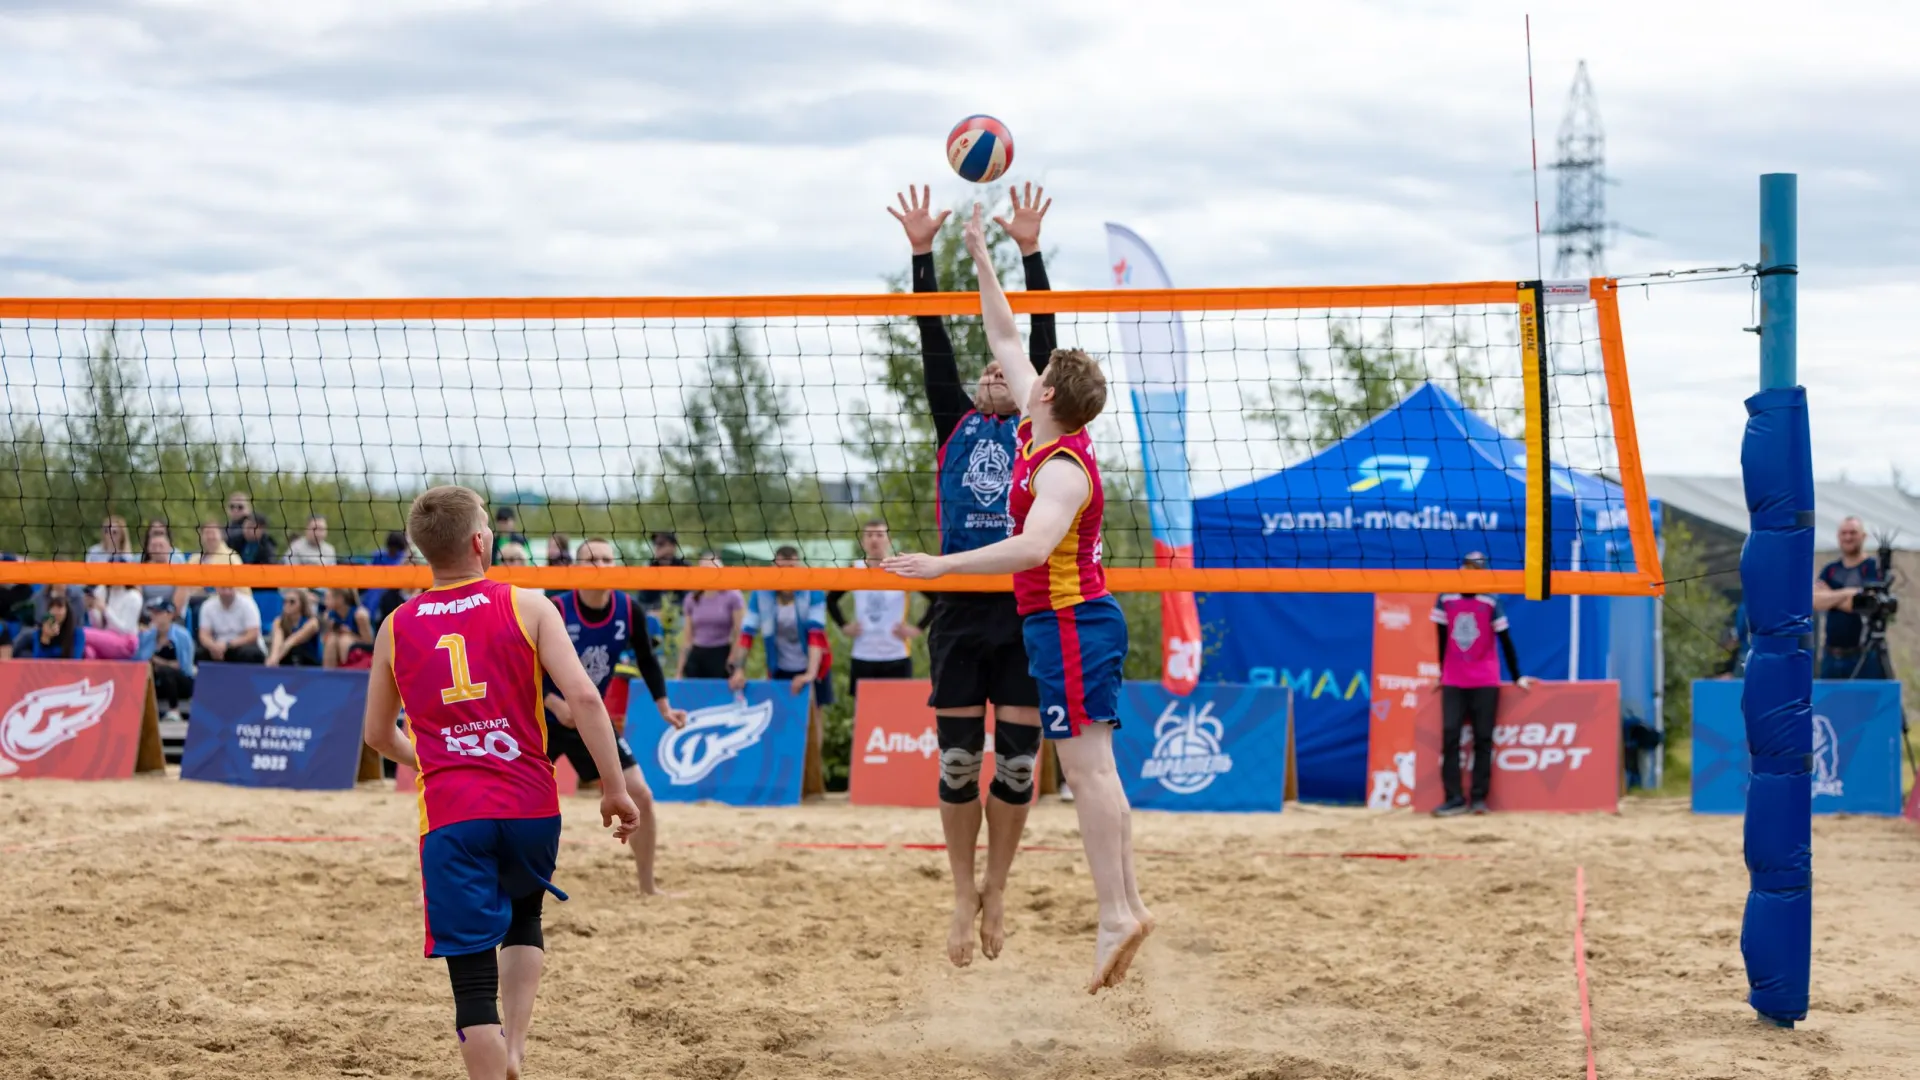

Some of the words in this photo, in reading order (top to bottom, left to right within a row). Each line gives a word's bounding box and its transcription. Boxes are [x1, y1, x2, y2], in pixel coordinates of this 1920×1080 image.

[1262, 506, 1499, 536] yamal-media.ru
[415, 592, 491, 617] ЯМАЛ
[614, 620, 626, 641] 2
[434, 632, 488, 705] 1
[1248, 666, 1371, 700] ЯМАЛ
[454, 717, 510, 735] САЛЕХАРД
[1046, 705, 1069, 732] 2
[236, 724, 262, 738] ГОД
[263, 725, 312, 740] ГЕРОЕВ
[239, 737, 257, 749] НА
[260, 738, 306, 752] ЯМАЛЕ
